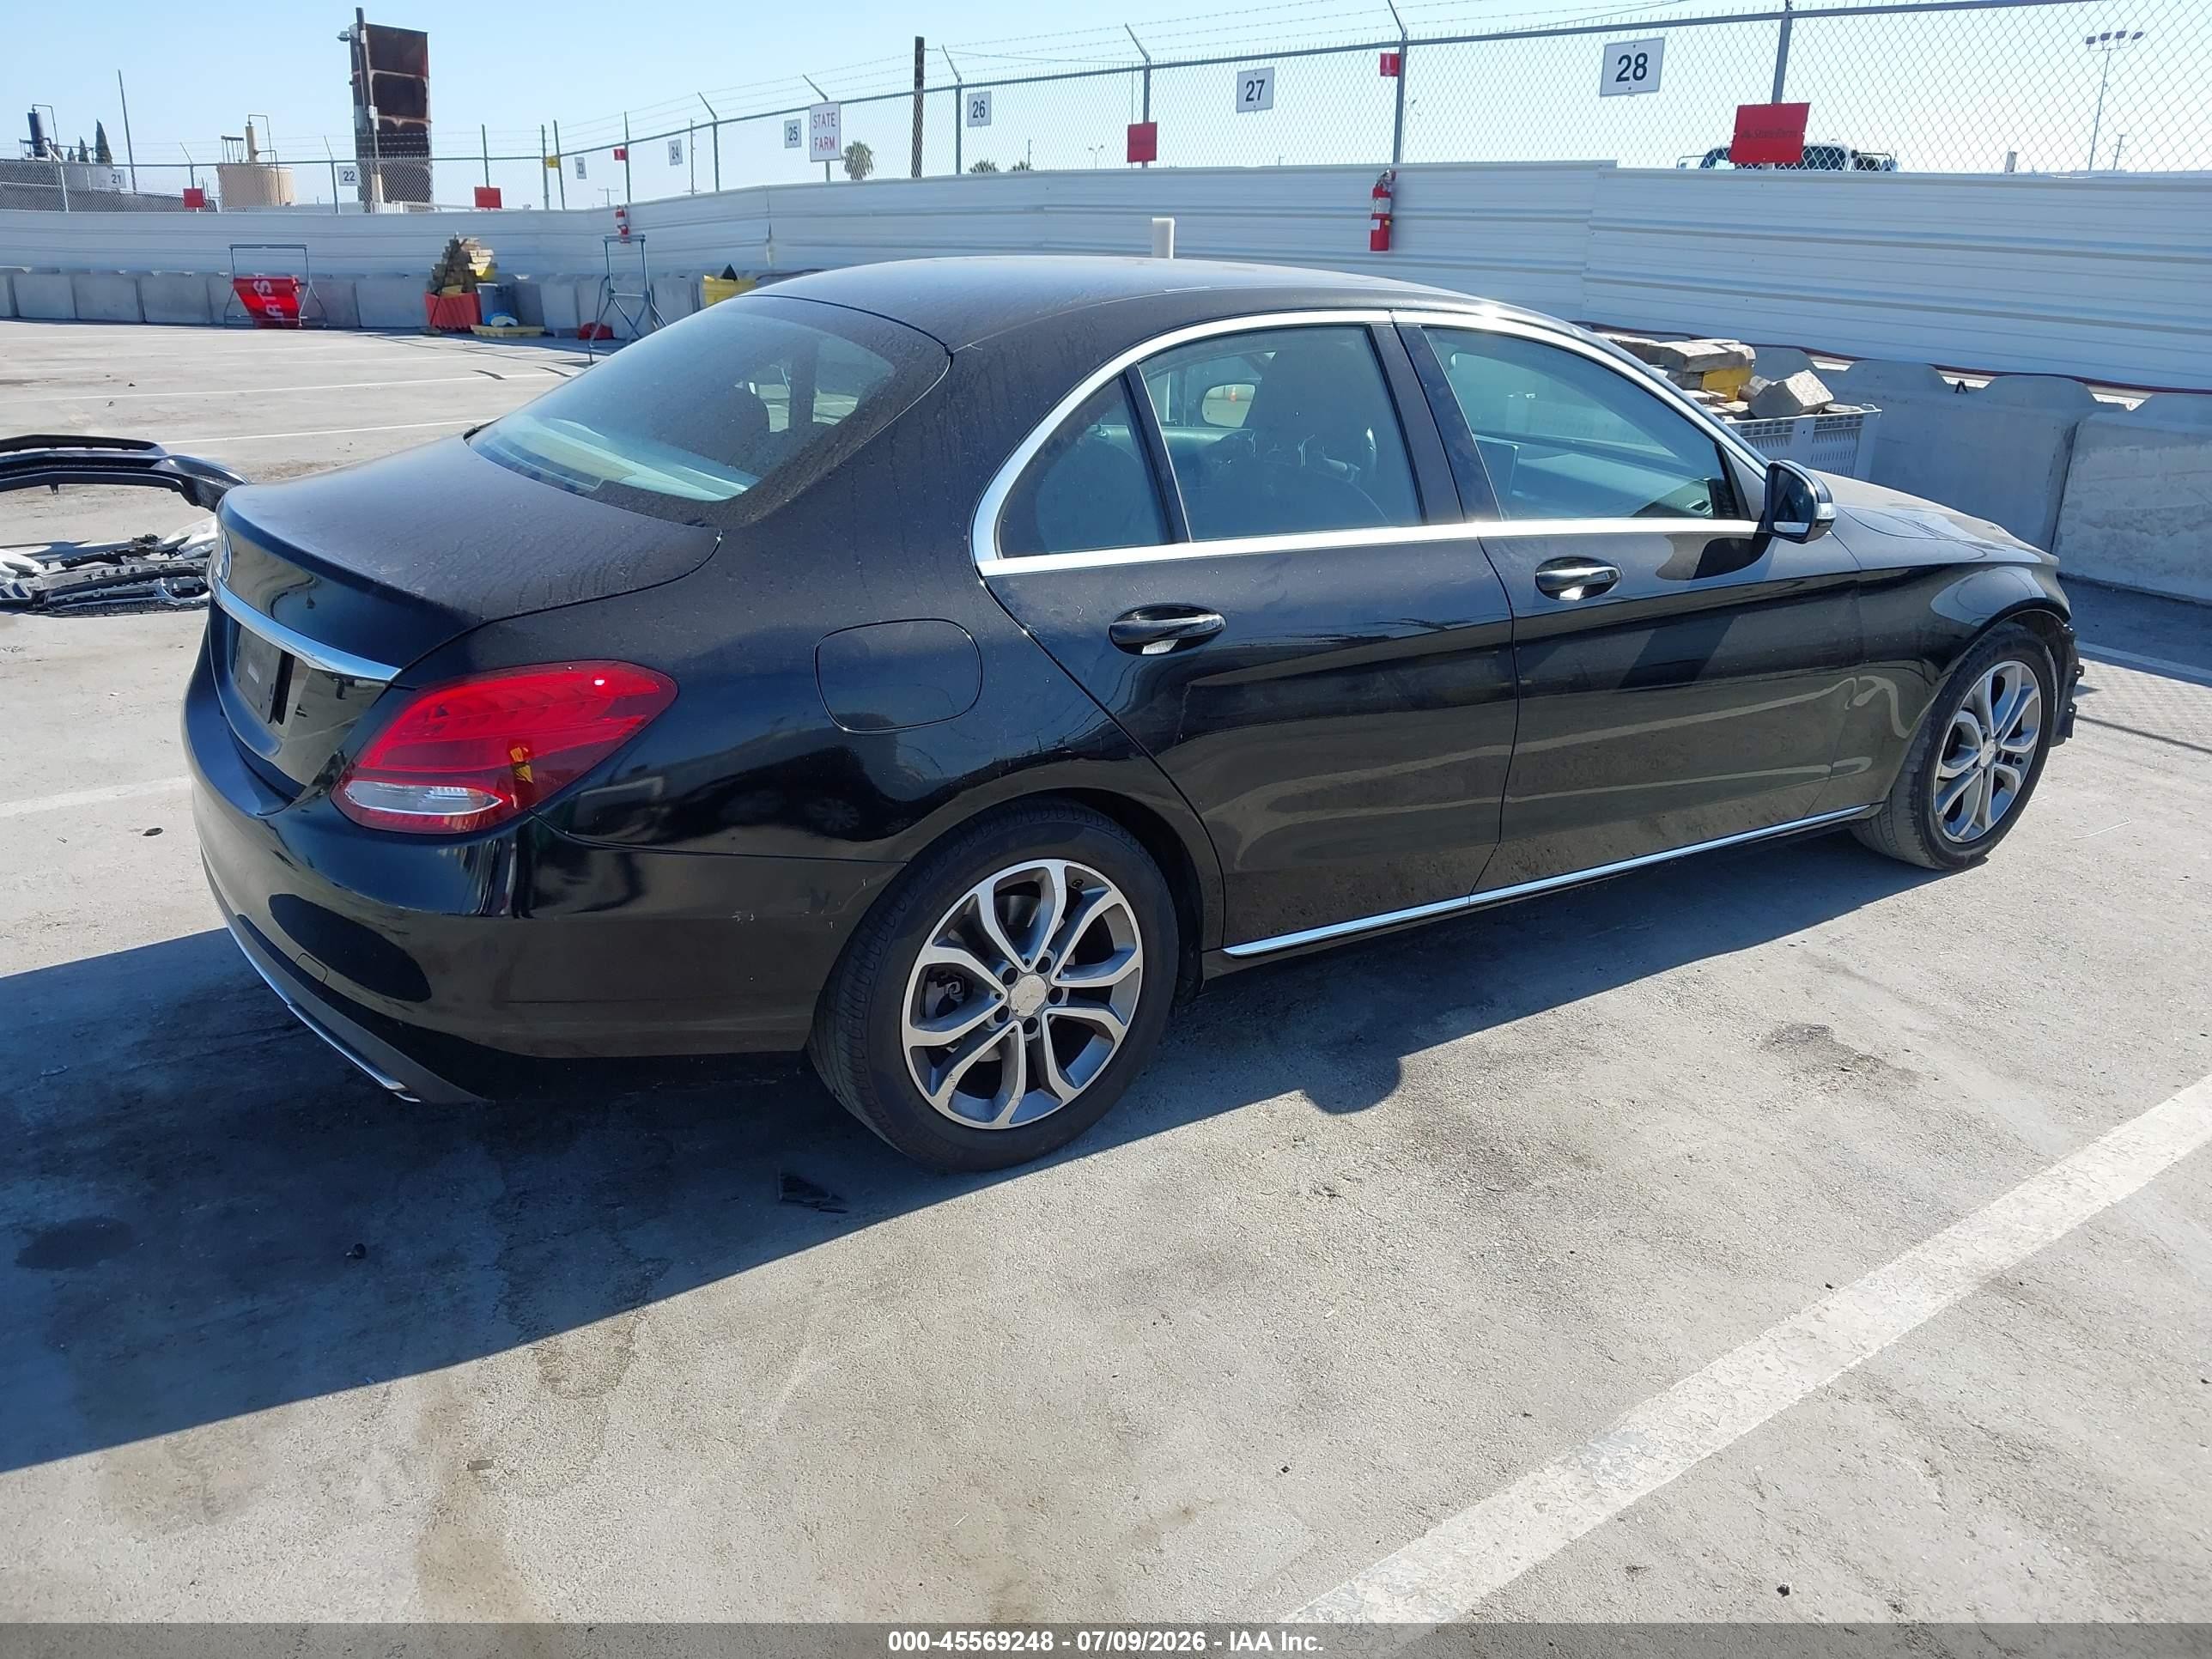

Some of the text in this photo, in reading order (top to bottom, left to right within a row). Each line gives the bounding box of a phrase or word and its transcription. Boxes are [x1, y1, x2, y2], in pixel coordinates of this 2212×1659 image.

[1615, 52, 1649, 82] 28
[1245, 78, 1266, 102] 27
[972, 100, 986, 118] 26
[813, 112, 836, 130] STATE
[788, 125, 799, 142] 25
[814, 135, 836, 151] FARM
[672, 145, 679, 159] 24
[112, 173, 121, 184] 21
[343, 170, 356, 182] 22
